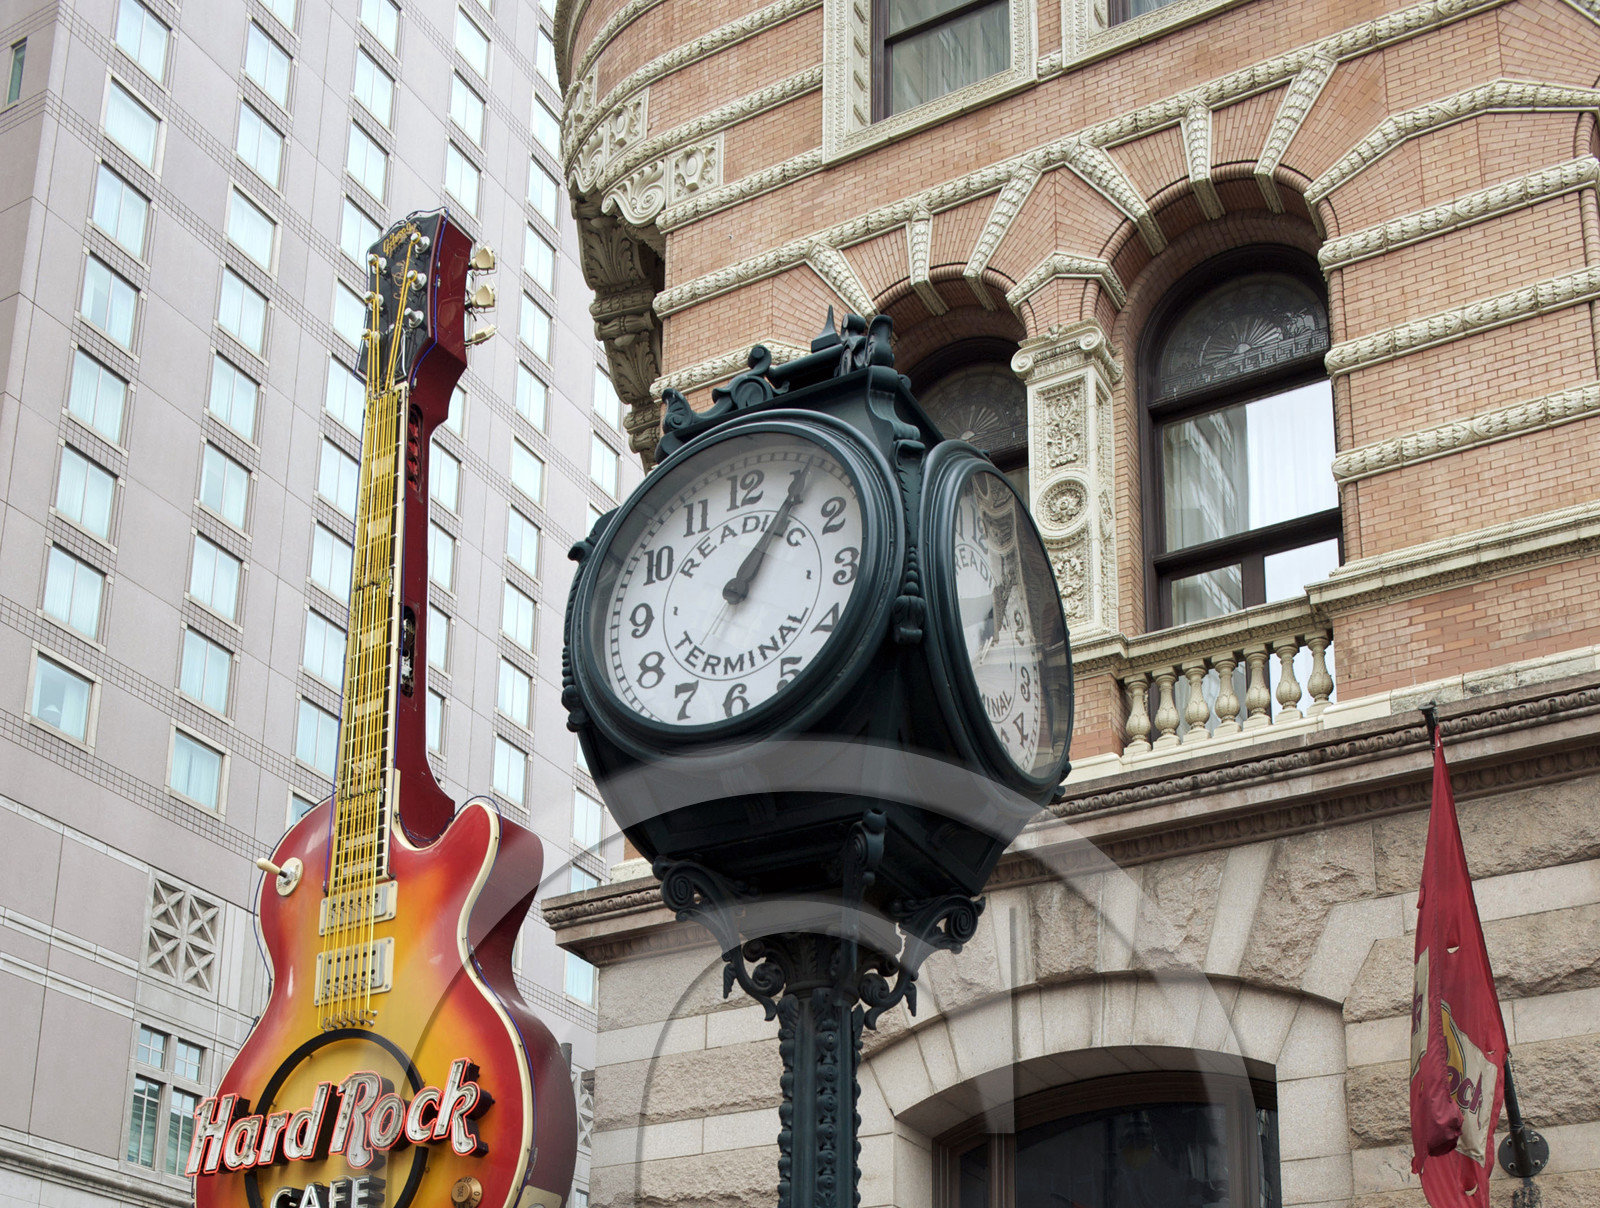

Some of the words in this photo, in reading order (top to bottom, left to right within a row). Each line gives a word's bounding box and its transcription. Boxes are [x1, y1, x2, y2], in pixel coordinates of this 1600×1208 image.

[726, 469, 765, 512] 12
[683, 498, 710, 538] 11
[821, 496, 847, 535] 2
[643, 545, 675, 586] 10
[832, 546, 860, 586] 3
[629, 602, 655, 639] 9
[810, 602, 841, 634] 4
[673, 606, 810, 676] TERMINAL
[636, 651, 666, 690] 8
[777, 656, 803, 692] 5
[674, 680, 699, 721] 7
[722, 683, 751, 718] 6
[185, 1081, 332, 1176] Hard
[329, 1057, 480, 1169] Rock
